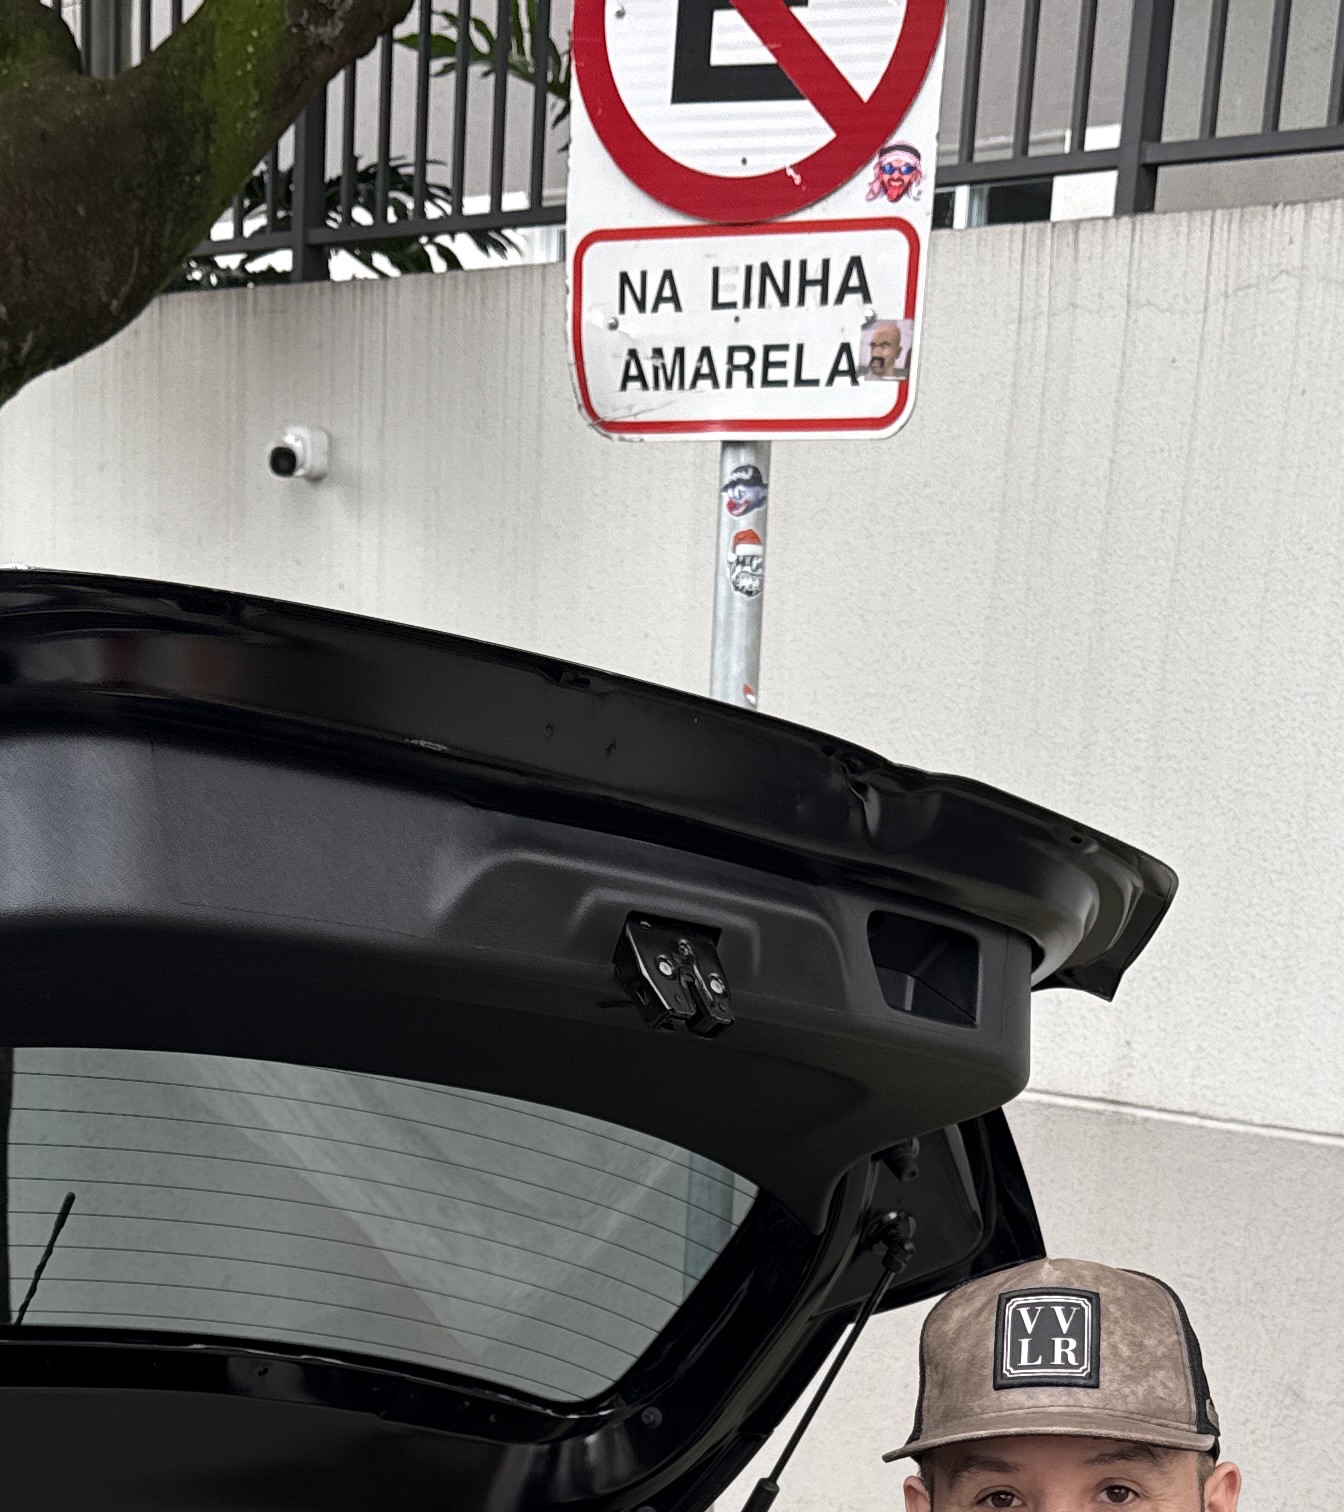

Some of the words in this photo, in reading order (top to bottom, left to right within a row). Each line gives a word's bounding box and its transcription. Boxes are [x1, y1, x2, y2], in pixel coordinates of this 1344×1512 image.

[618, 268, 683, 315] NA
[711, 254, 873, 311] LINHA
[618, 342, 861, 392] AMARELA
